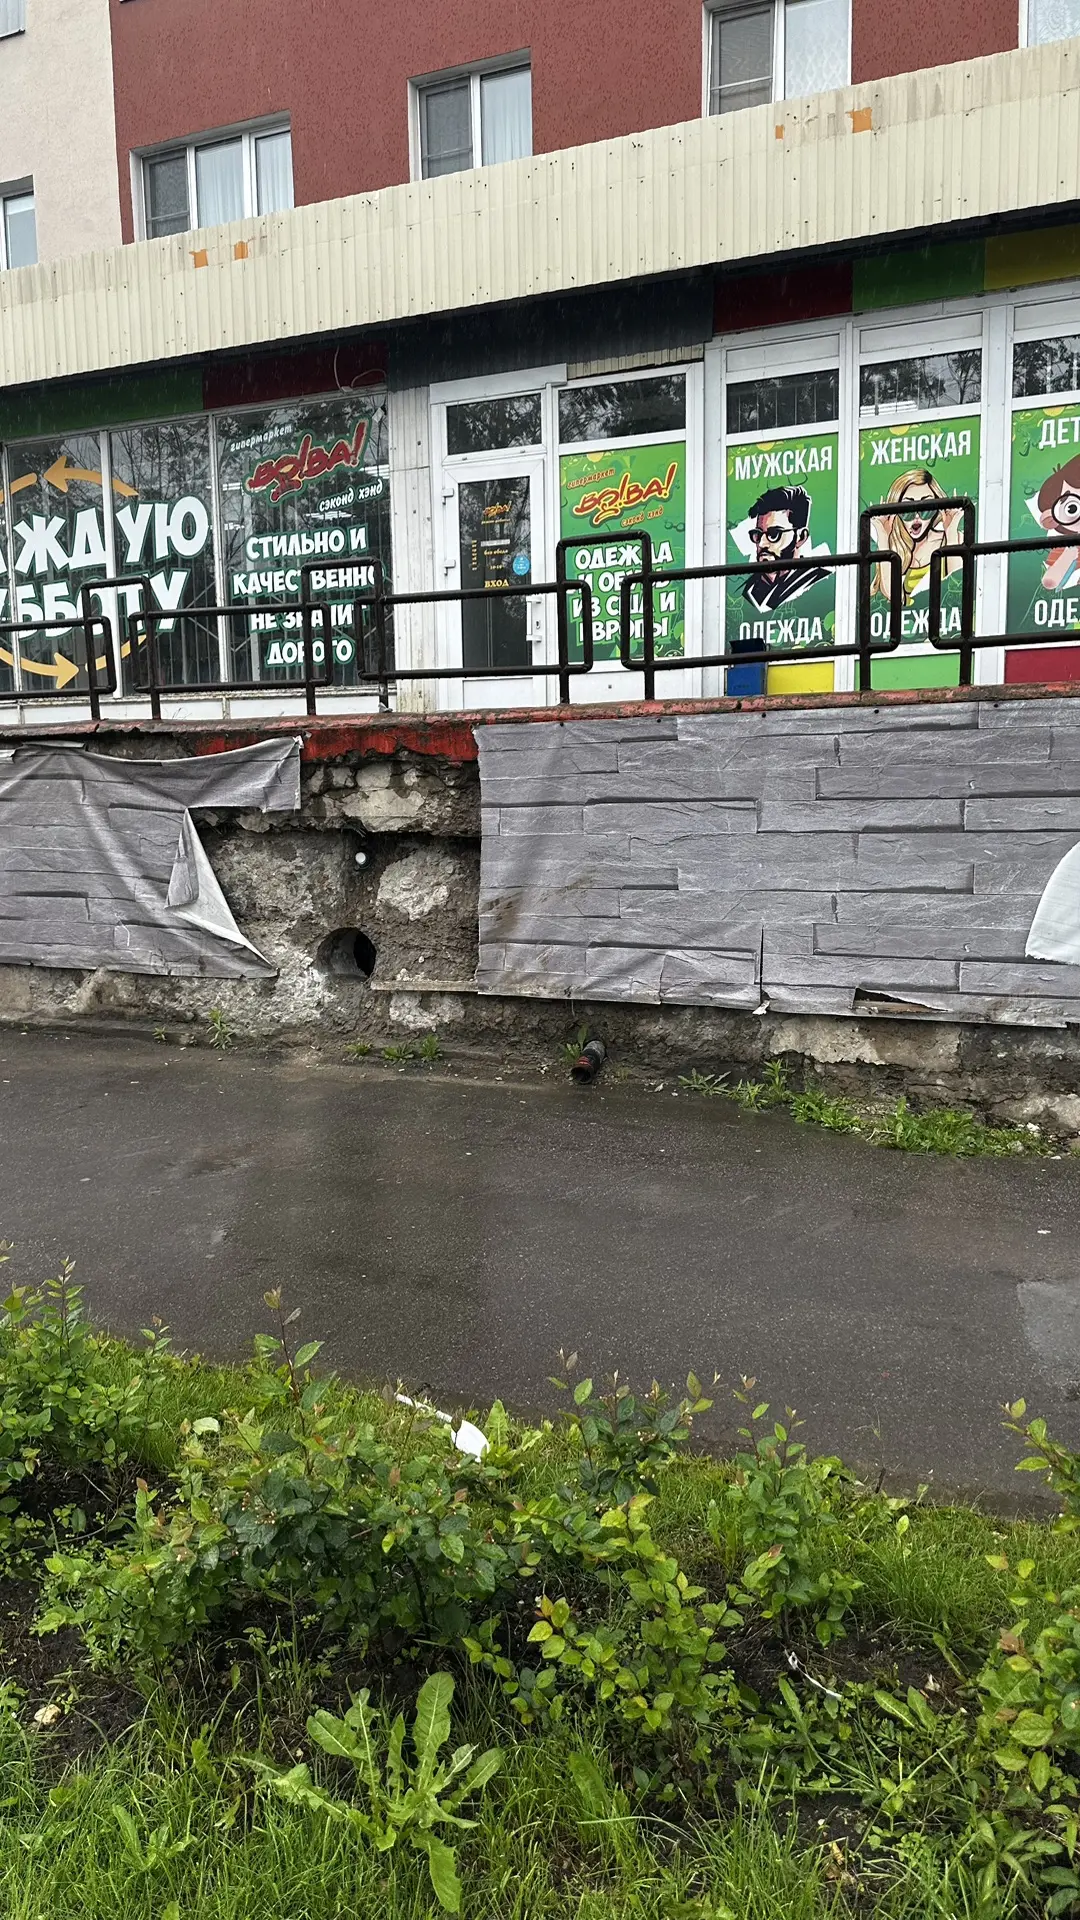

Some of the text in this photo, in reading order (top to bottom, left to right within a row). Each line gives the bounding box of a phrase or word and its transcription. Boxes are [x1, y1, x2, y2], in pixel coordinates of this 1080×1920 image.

[230, 424, 293, 452] гипермаркет
[870, 430, 971, 466] ЖЕНСКАЯ
[735, 446, 832, 481] МУЖСКАЯ
[319, 478, 383, 512] сэконд хэнд
[0, 496, 208, 574] ЖДУЮ
[246, 527, 366, 560] СТИЛЬНО И
[484, 579, 510, 588] ВХОД
[660, 591, 676, 613] И
